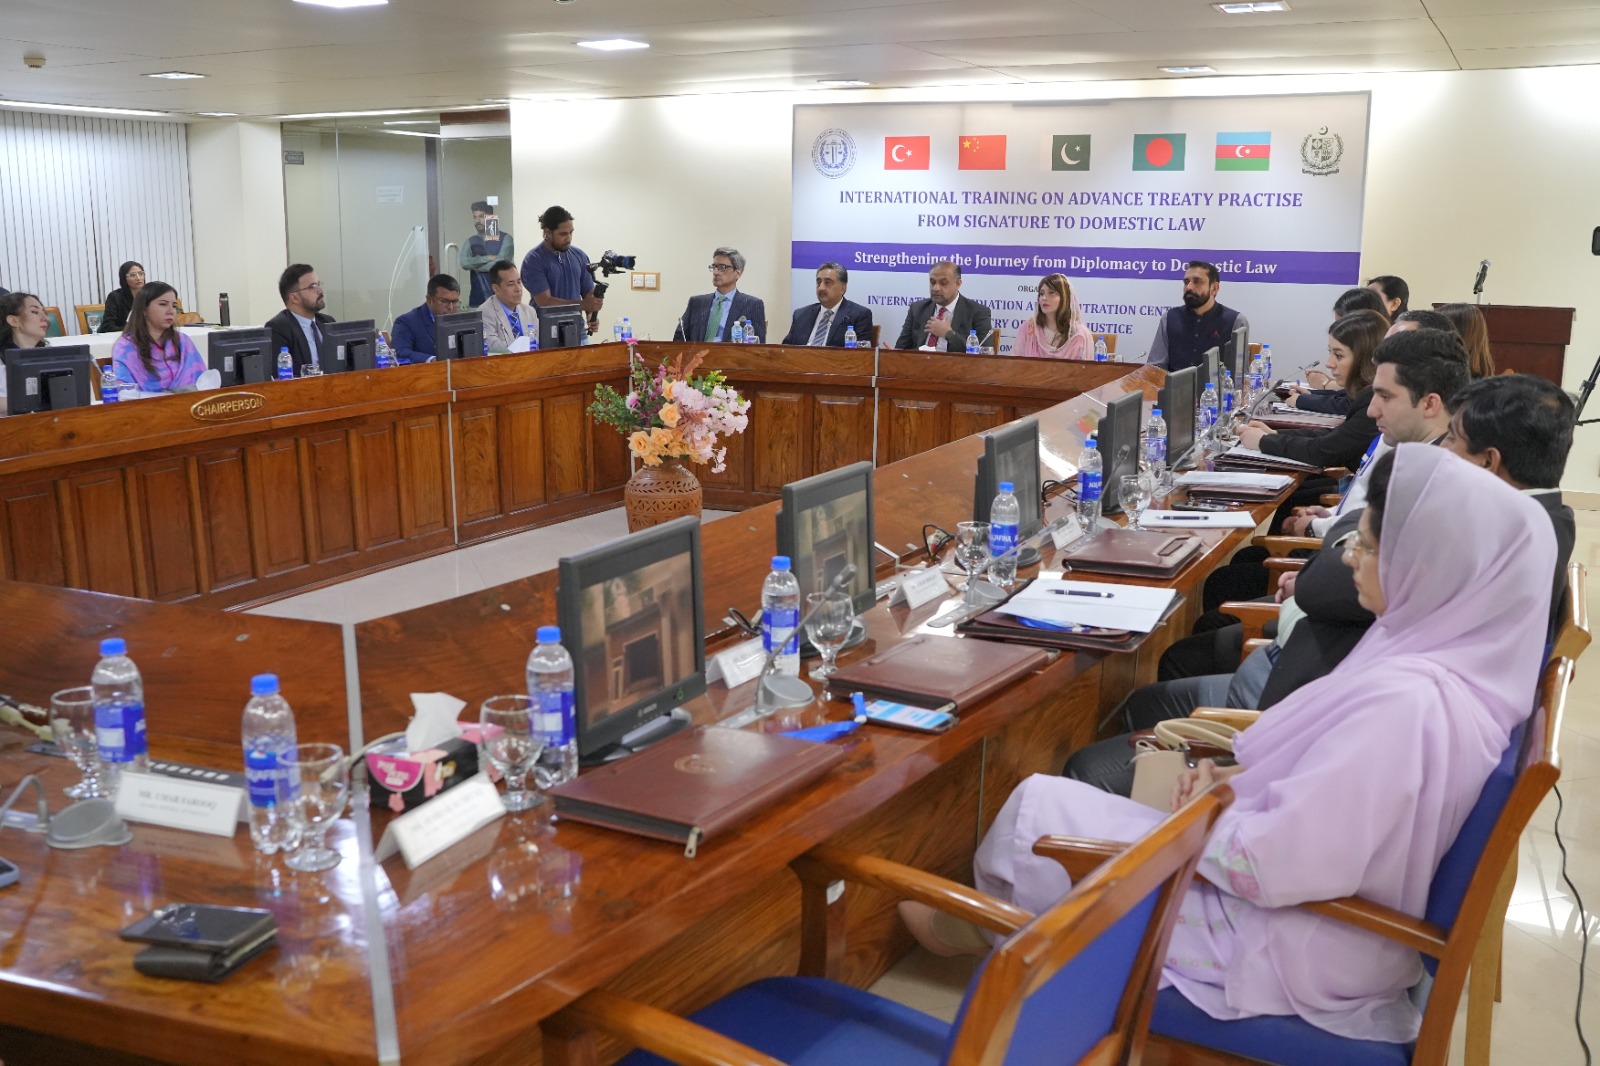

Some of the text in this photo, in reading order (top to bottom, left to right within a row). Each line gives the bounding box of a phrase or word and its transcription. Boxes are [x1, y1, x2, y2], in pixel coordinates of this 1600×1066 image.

[839, 190, 1303, 207] INTERNATIONAL TRAINING ON ADVANCE TREATY PRACTISE
[917, 214, 1206, 231] FROM SIGNATURE TO DOMESTIC LAW
[950, 253, 972, 266] the
[975, 254, 1029, 270] Journey
[1033, 255, 1067, 268] from
[1070, 256, 1148, 273] Diplomacy
[1151, 259, 1167, 271] to
[1170, 258, 1242, 273] Dostic
[1245, 260, 1277, 274] Law
[1017, 285, 1038, 293] ORGA
[1079, 303, 1136, 316] TRATION
[197, 398, 263, 416] CHAIRPERSON
